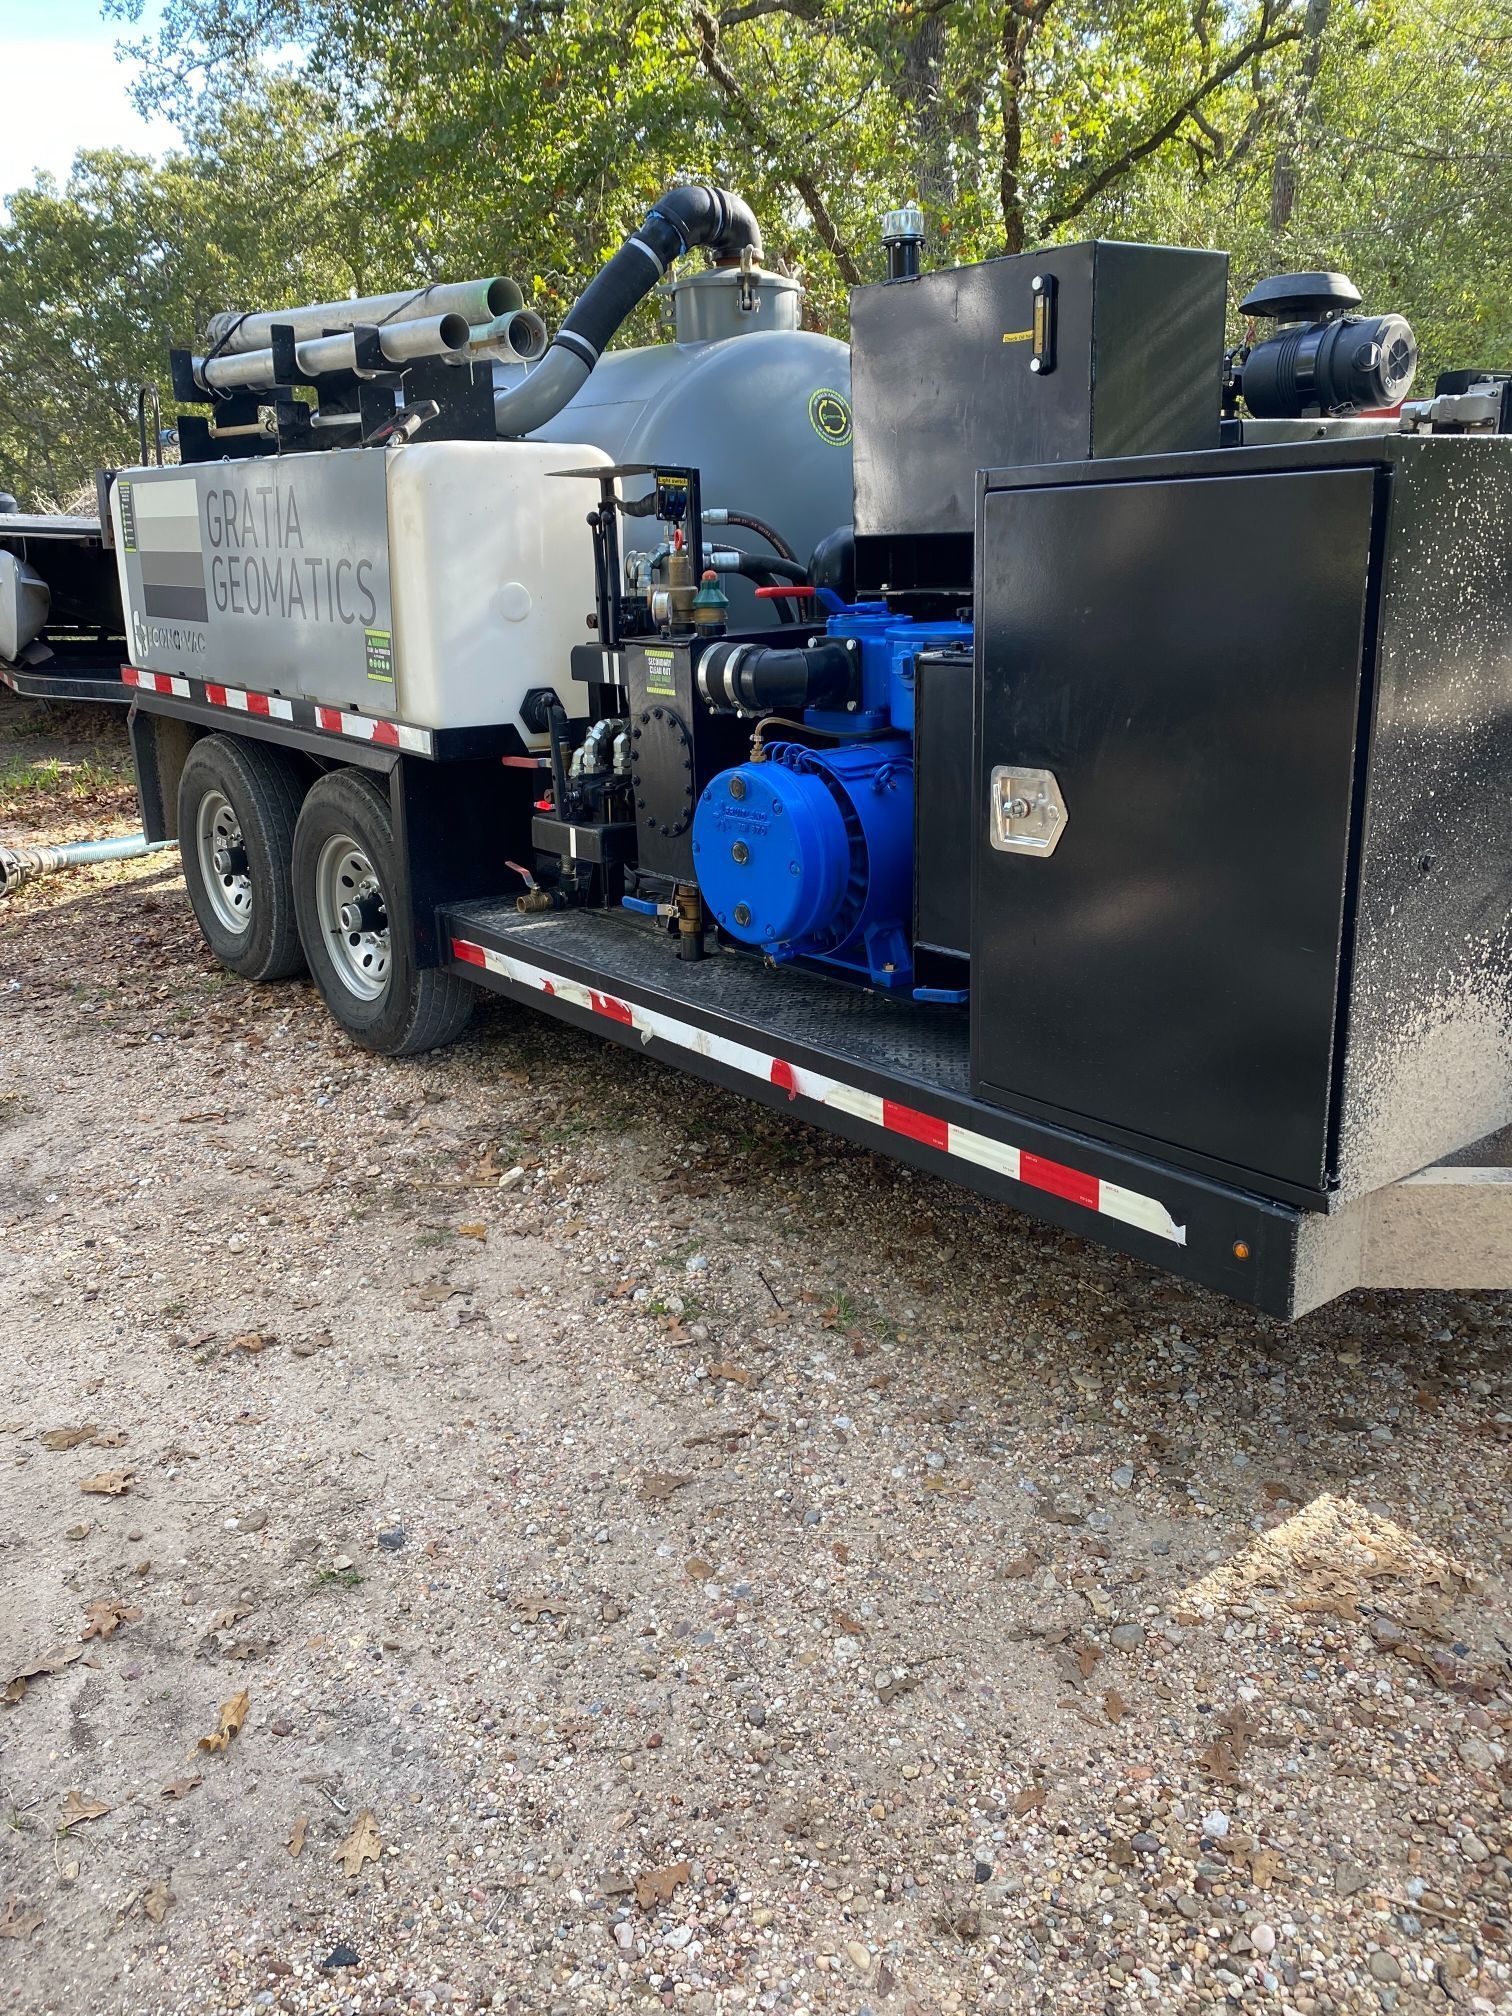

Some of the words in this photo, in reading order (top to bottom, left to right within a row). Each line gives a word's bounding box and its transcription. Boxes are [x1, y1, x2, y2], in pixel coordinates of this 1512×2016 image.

[658, 477, 671, 485] Light
[206, 485, 304, 549] GRATIA
[211, 556, 377, 627] GEOMATICS
[648, 656, 672, 668] SECONDARY
[662, 667, 671, 676] OUT
